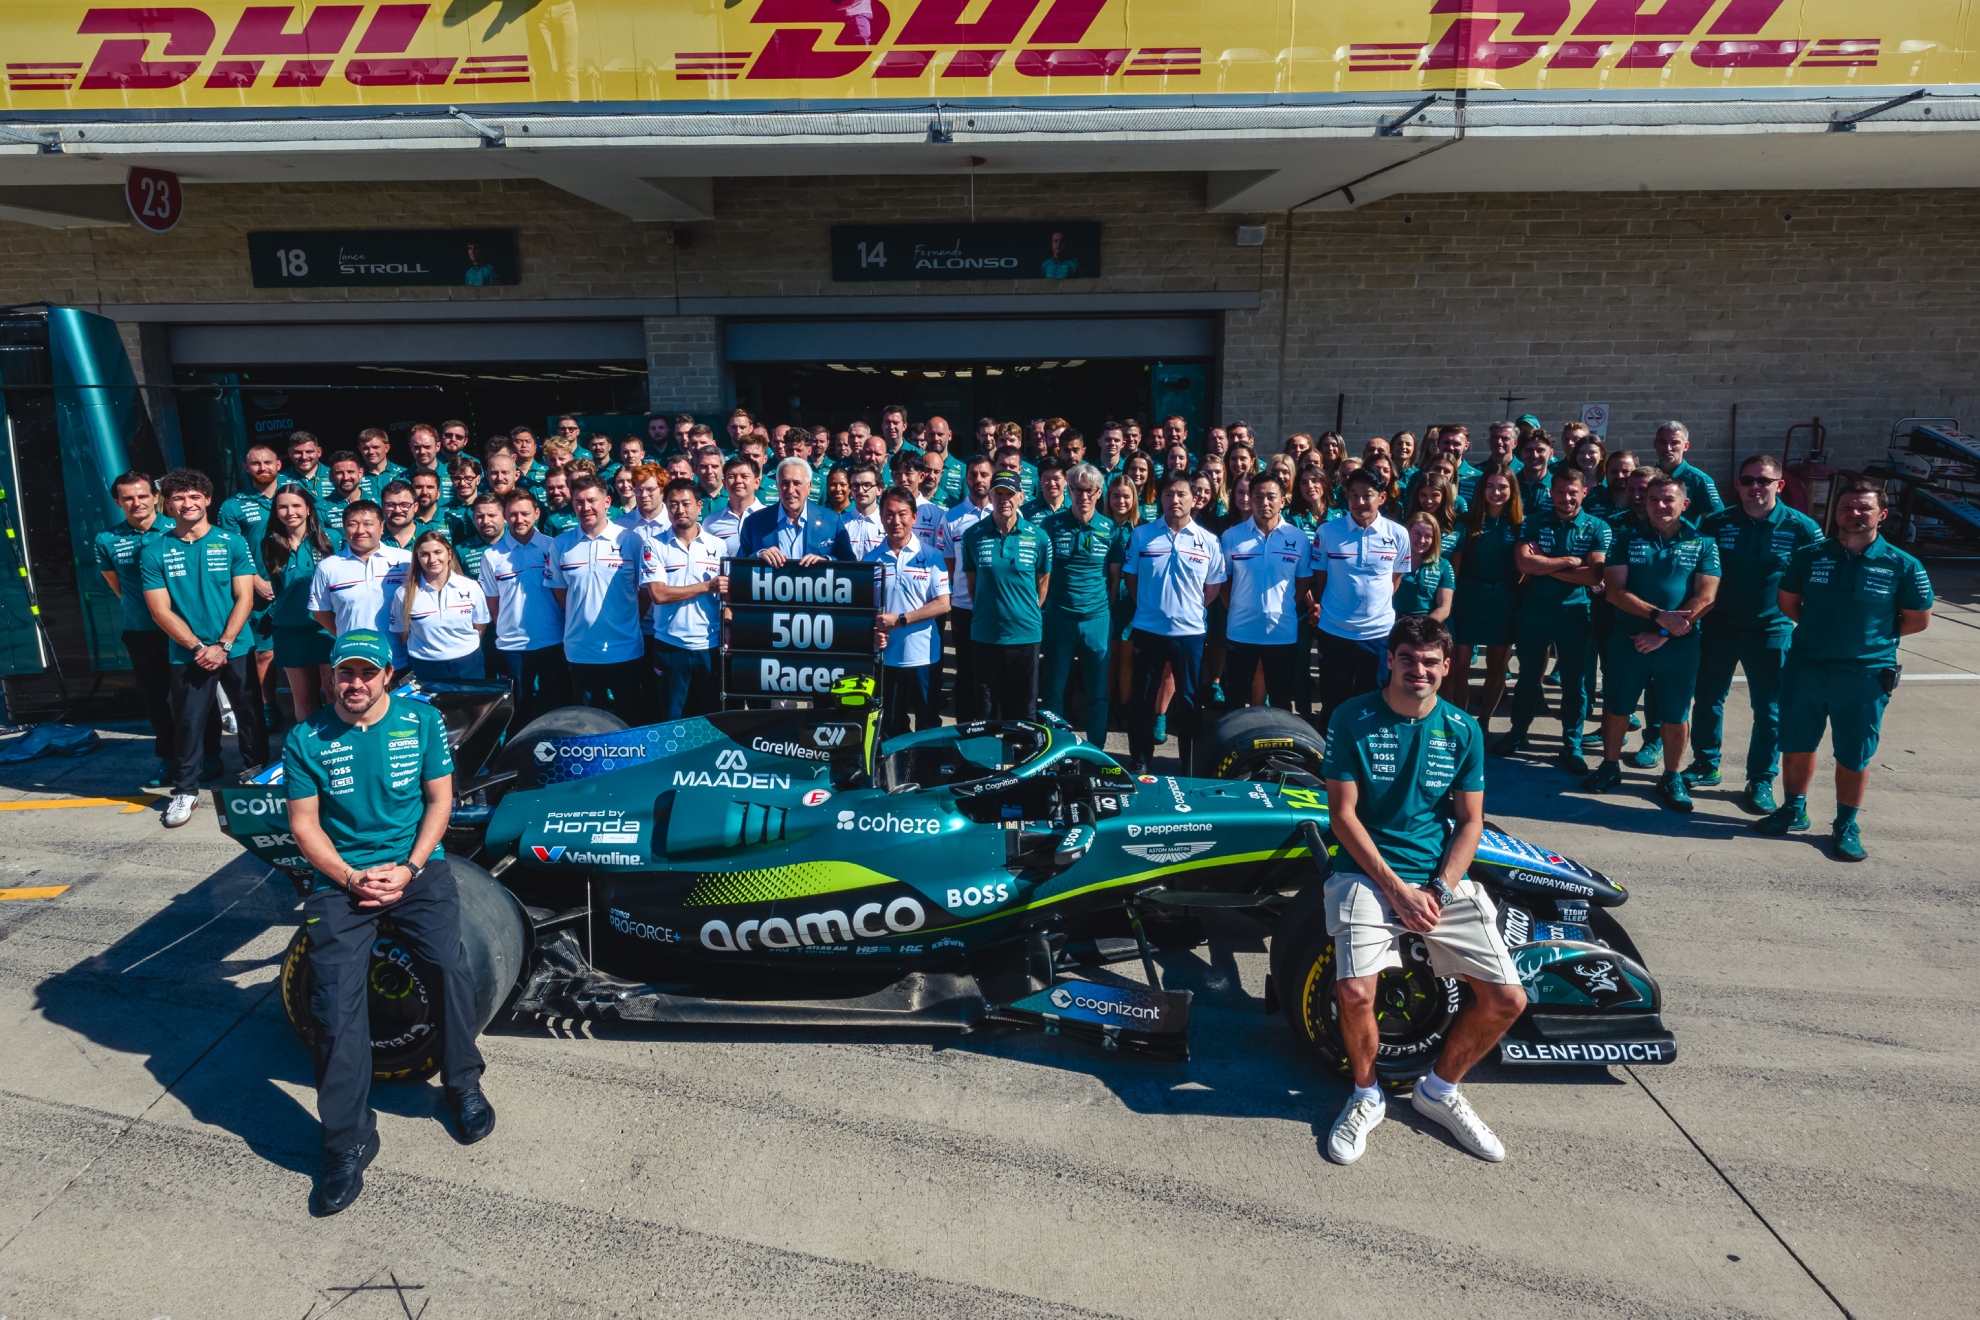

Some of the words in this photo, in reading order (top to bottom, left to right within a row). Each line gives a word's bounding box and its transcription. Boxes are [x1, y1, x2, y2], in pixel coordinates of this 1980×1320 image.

[77, 4, 459, 90] DHL
[745, 0, 1131, 79] DHL
[140, 175, 171, 220] 23
[338, 246, 366, 266] Lance
[857, 241, 887, 268] 14
[914, 238, 963, 260] Fernando
[276, 249, 308, 277] 18
[340, 262, 430, 274] STROLL
[916, 257, 1018, 269] ALONSO
[255, 418, 294, 432] aramco
[752, 567, 853, 604] Honda
[772, 612, 834, 650] 500
[1042, 710, 1061, 722] BOSS
[320, 745, 353, 756] MAADEN
[388, 739, 419, 748] aramco
[752, 736, 831, 762] CoreWeave
[1254, 738, 1294, 749] PIRELLI
[1429, 739, 1457, 748] aramco
[560, 743, 646, 762] cognizant
[1373, 753, 1395, 761] BOSS
[672, 771, 791, 790] MAADEN
[1426, 769, 1454, 777] CoreWeave
[984, 777, 1019, 791] Cognition
[1165, 775, 1186, 806] cognizant
[1426, 780, 1442, 788] BK8
[547, 810, 605, 818] Powered
[543, 819, 640, 833] Honda
[858, 813, 940, 834] cohere
[1144, 823, 1213, 835] pepperstone
[252, 834, 297, 848] BK
[1063, 828, 1082, 847] BOSS
[565, 852, 640, 865] Valvoline
[1518, 872, 1594, 897] COINPAYMENTS
[947, 884, 1009, 908] BOSS
[609, 907, 630, 919] aramco
[700, 897, 925, 951] aramco
[900, 945, 923, 953] HRC
[932, 936, 965, 949] KROWN
[1075, 996, 1160, 1020] cognizant
[1506, 1044, 1662, 1060] GLENFIDDICH
